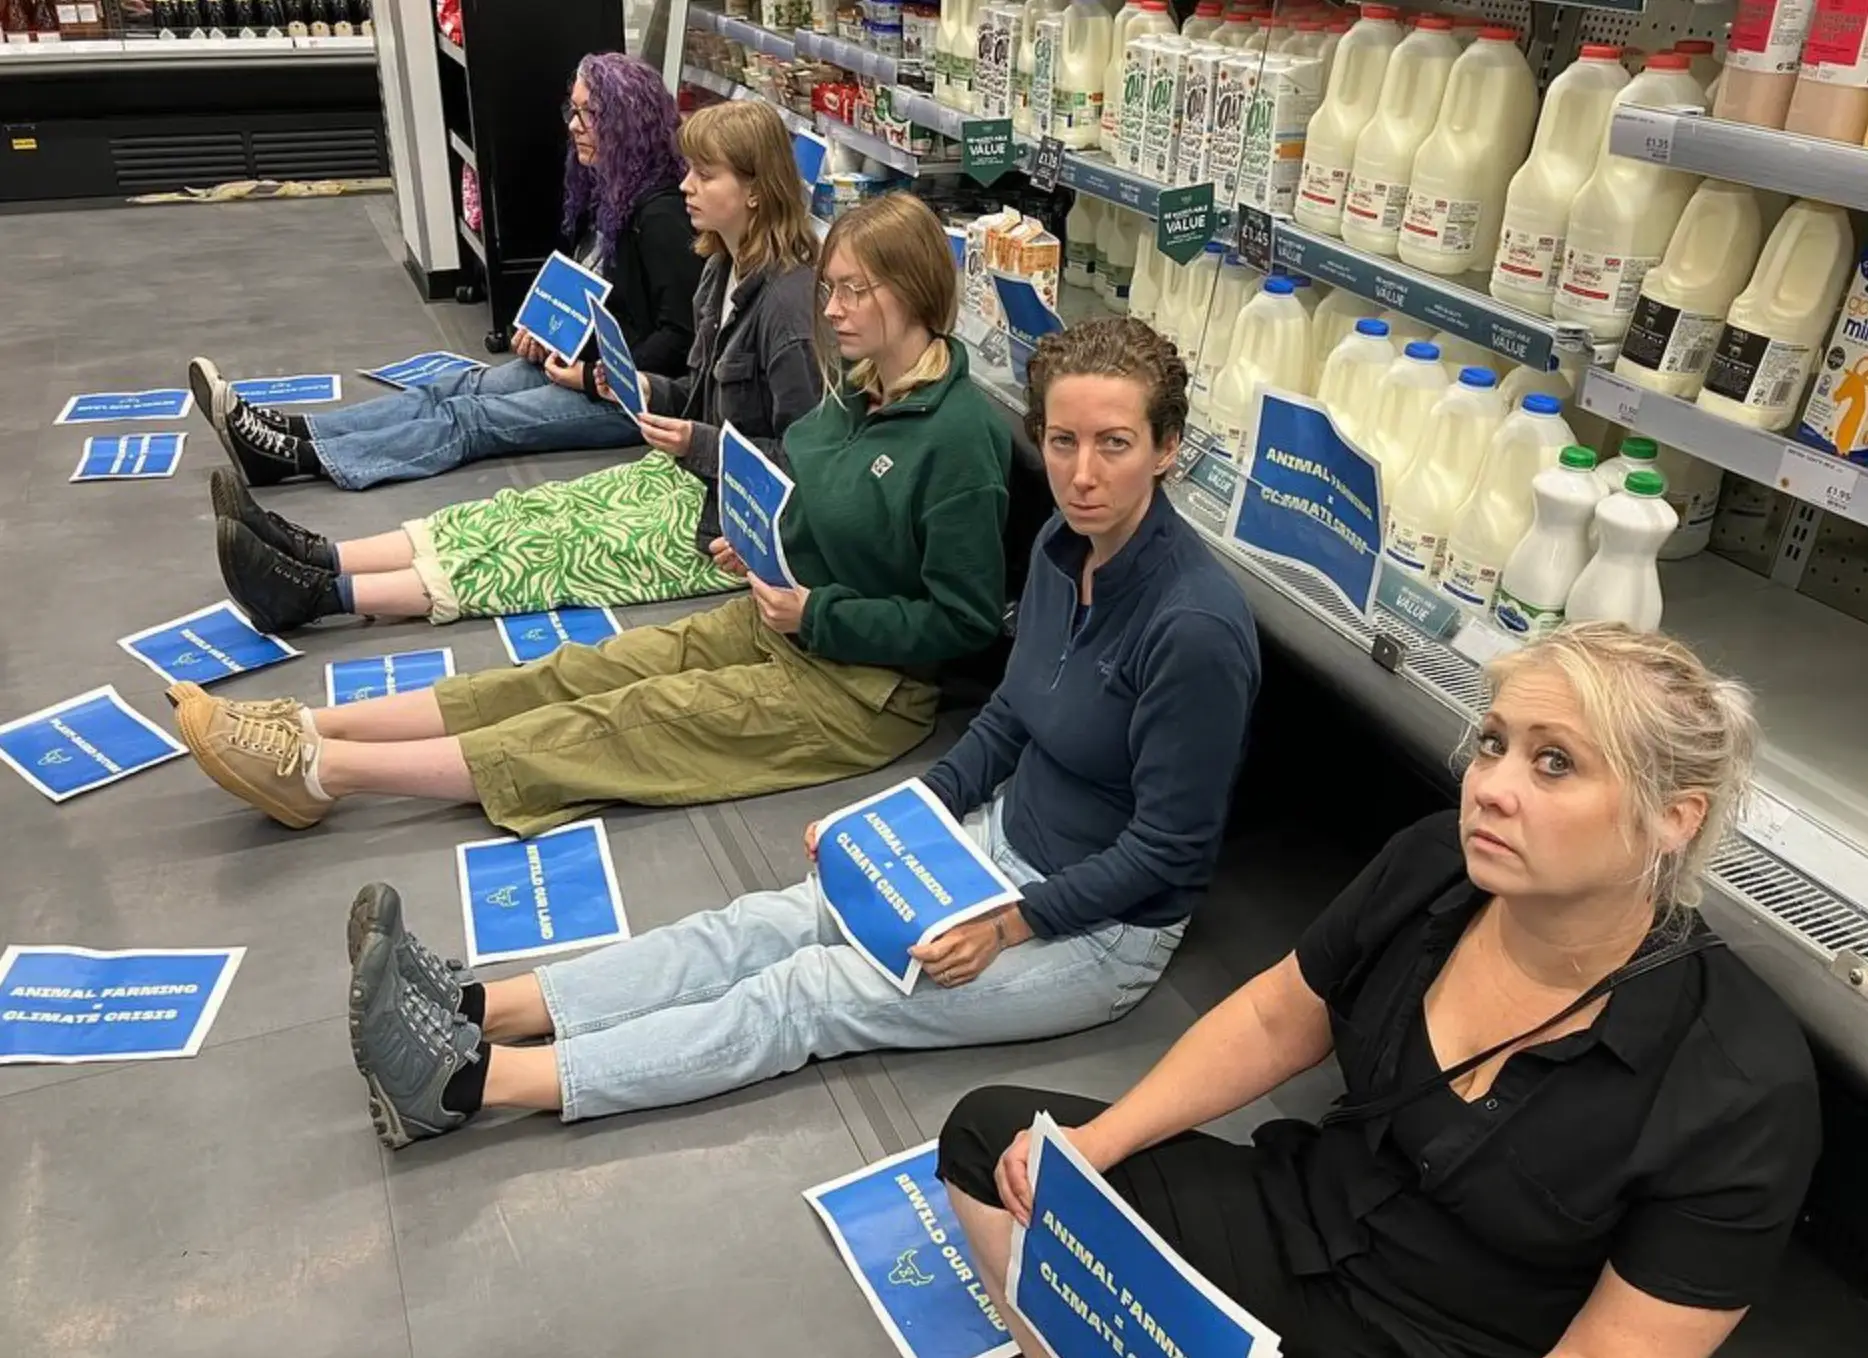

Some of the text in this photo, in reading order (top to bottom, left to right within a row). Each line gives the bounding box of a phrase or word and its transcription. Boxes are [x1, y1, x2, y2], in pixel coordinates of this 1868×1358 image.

[968, 143, 1006, 156] VALUE
[1646, 136, 1669, 149] £1.35
[1165, 214, 1206, 234] VALUE
[1241, 223, 1270, 247] £1.45
[1276, 243, 1303, 266] VALUE
[1375, 284, 1406, 308] VALUE
[1491, 332, 1528, 358] VALUE
[1265, 447, 1331, 482] ANIMAL
[1260, 487, 1335, 527] CLIMATE
[1395, 594, 1430, 623] VALUE
[862, 812, 954, 907] ANIMAL FARMING
[835, 831, 917, 923] CLIMATE CRISIS
[537, 908, 553, 940] LAND
[9, 983, 198, 999] ANIMAL FARMING
[2, 1008, 178, 1024] CLIMATE CRISIS
[894, 1172, 1008, 1332] REWILD OUR LAND
[1041, 1210, 1119, 1295] ANIMAL
[1039, 1261, 1126, 1357] CLIMATE
